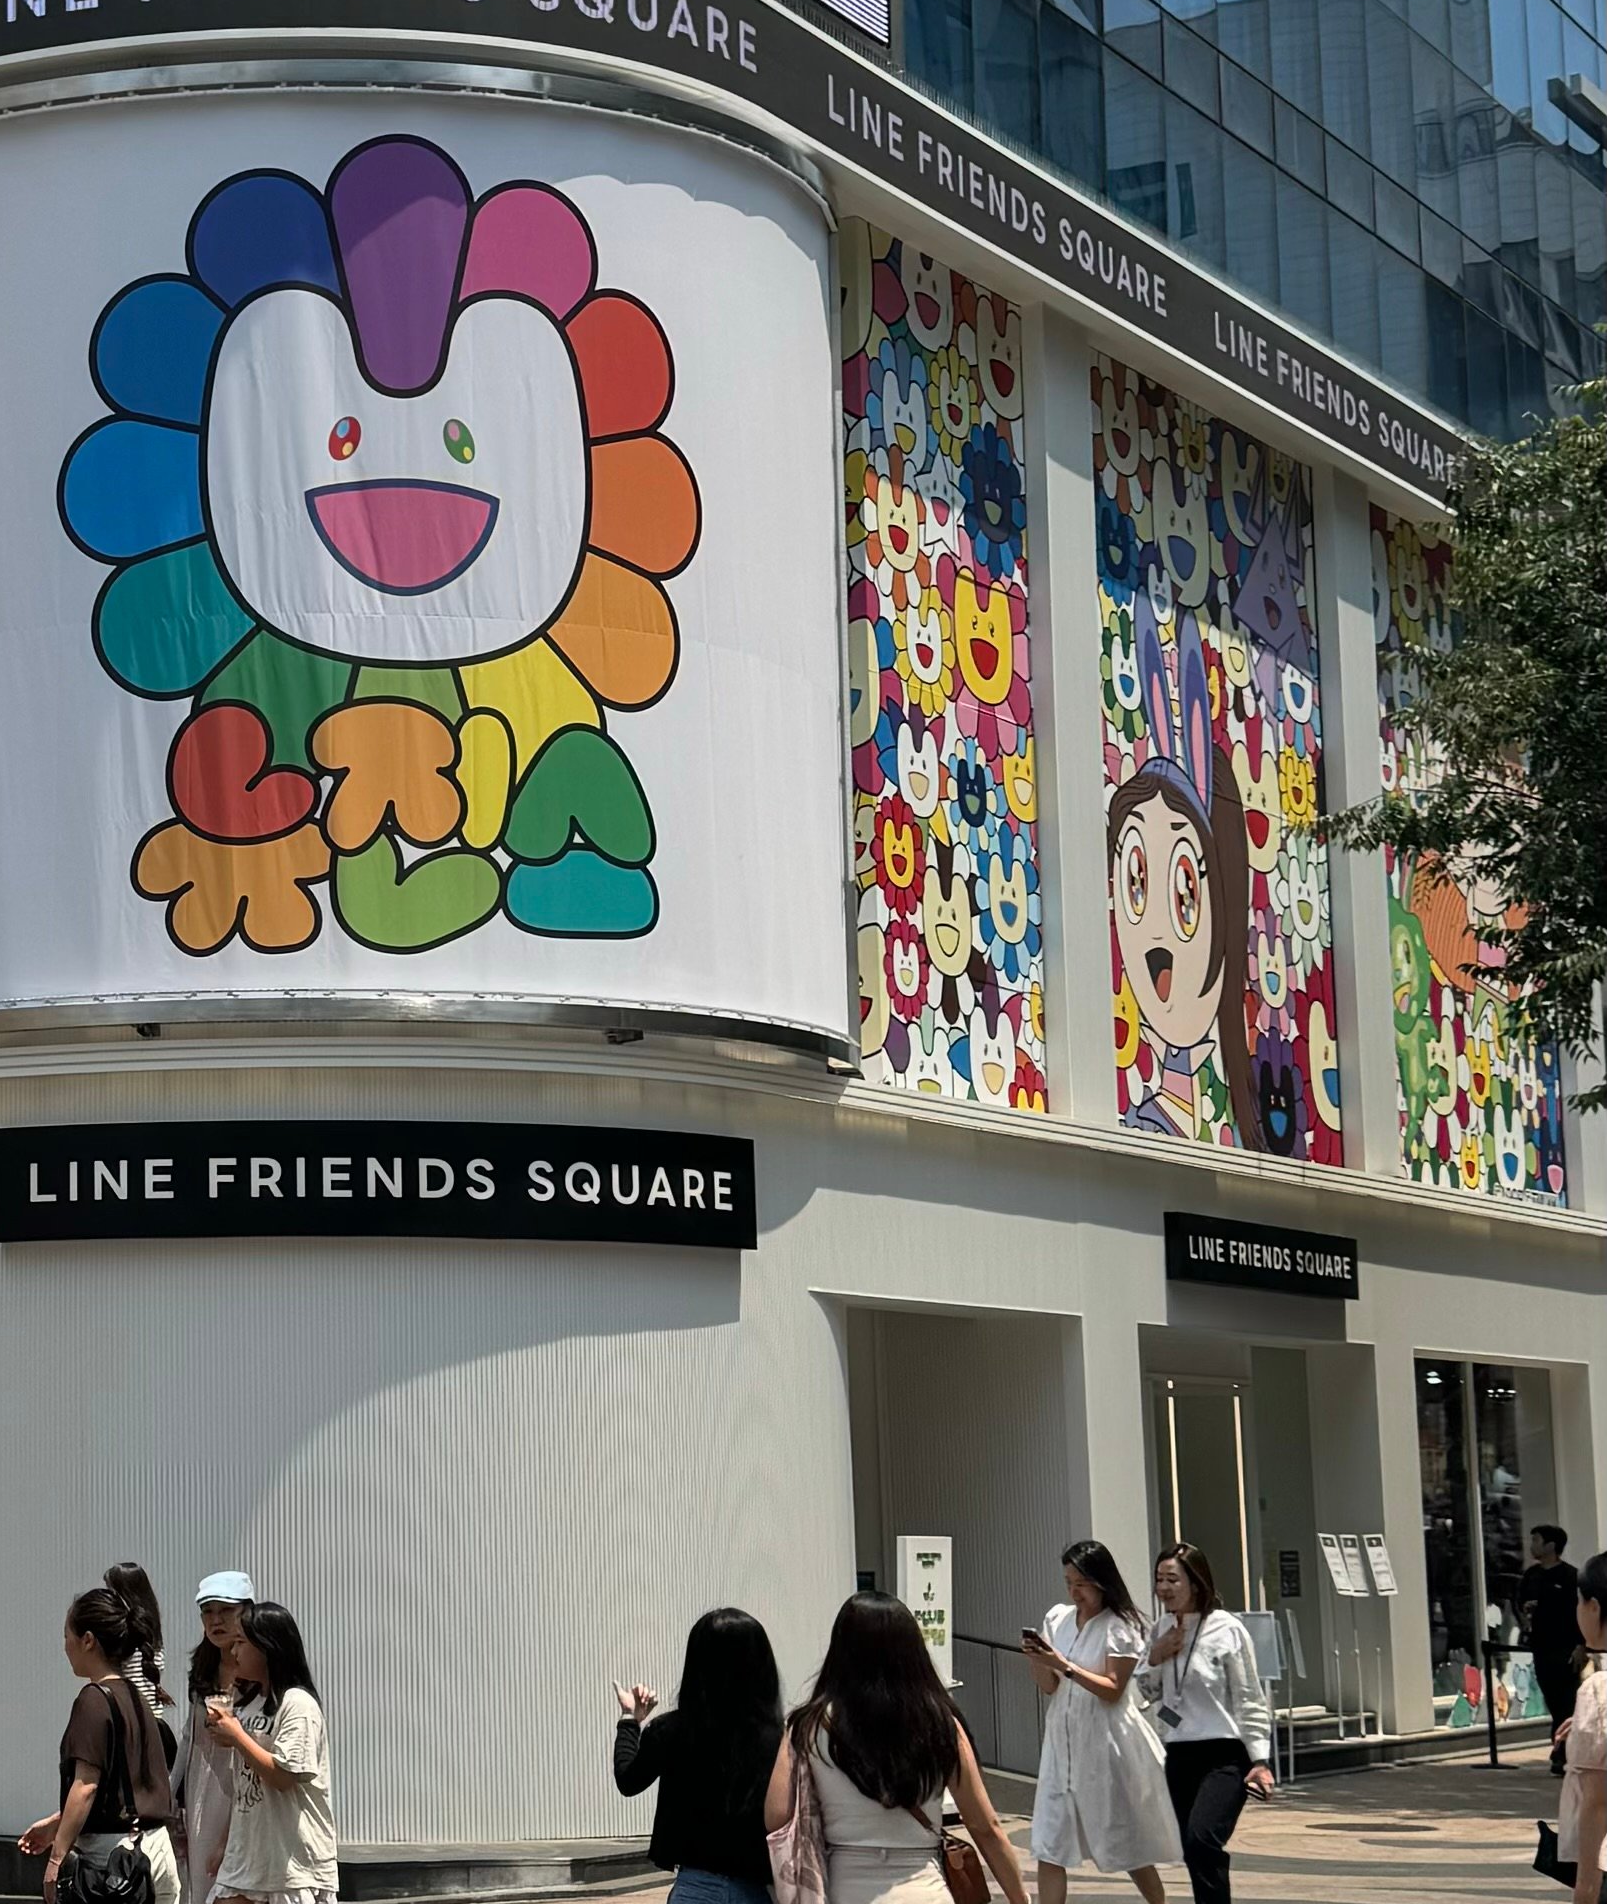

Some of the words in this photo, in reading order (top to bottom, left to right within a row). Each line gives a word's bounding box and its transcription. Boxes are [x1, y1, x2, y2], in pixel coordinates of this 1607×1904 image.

[829, 75, 904, 161] LINE
[919, 131, 1045, 244] FRIENDS
[1060, 219, 1166, 317] SQUARE
[1215, 312, 1268, 376] LINE
[1277, 350, 1370, 435] FRIENDS
[31, 1159, 173, 1202] LINE
[209, 1158, 494, 1199] FRIENDS
[528, 1161, 732, 1210] SQUARE
[1190, 1236, 1224, 1262] LINE
[1230, 1241, 1290, 1271] FRIENDS
[1297, 1251, 1351, 1278] SQUARE
